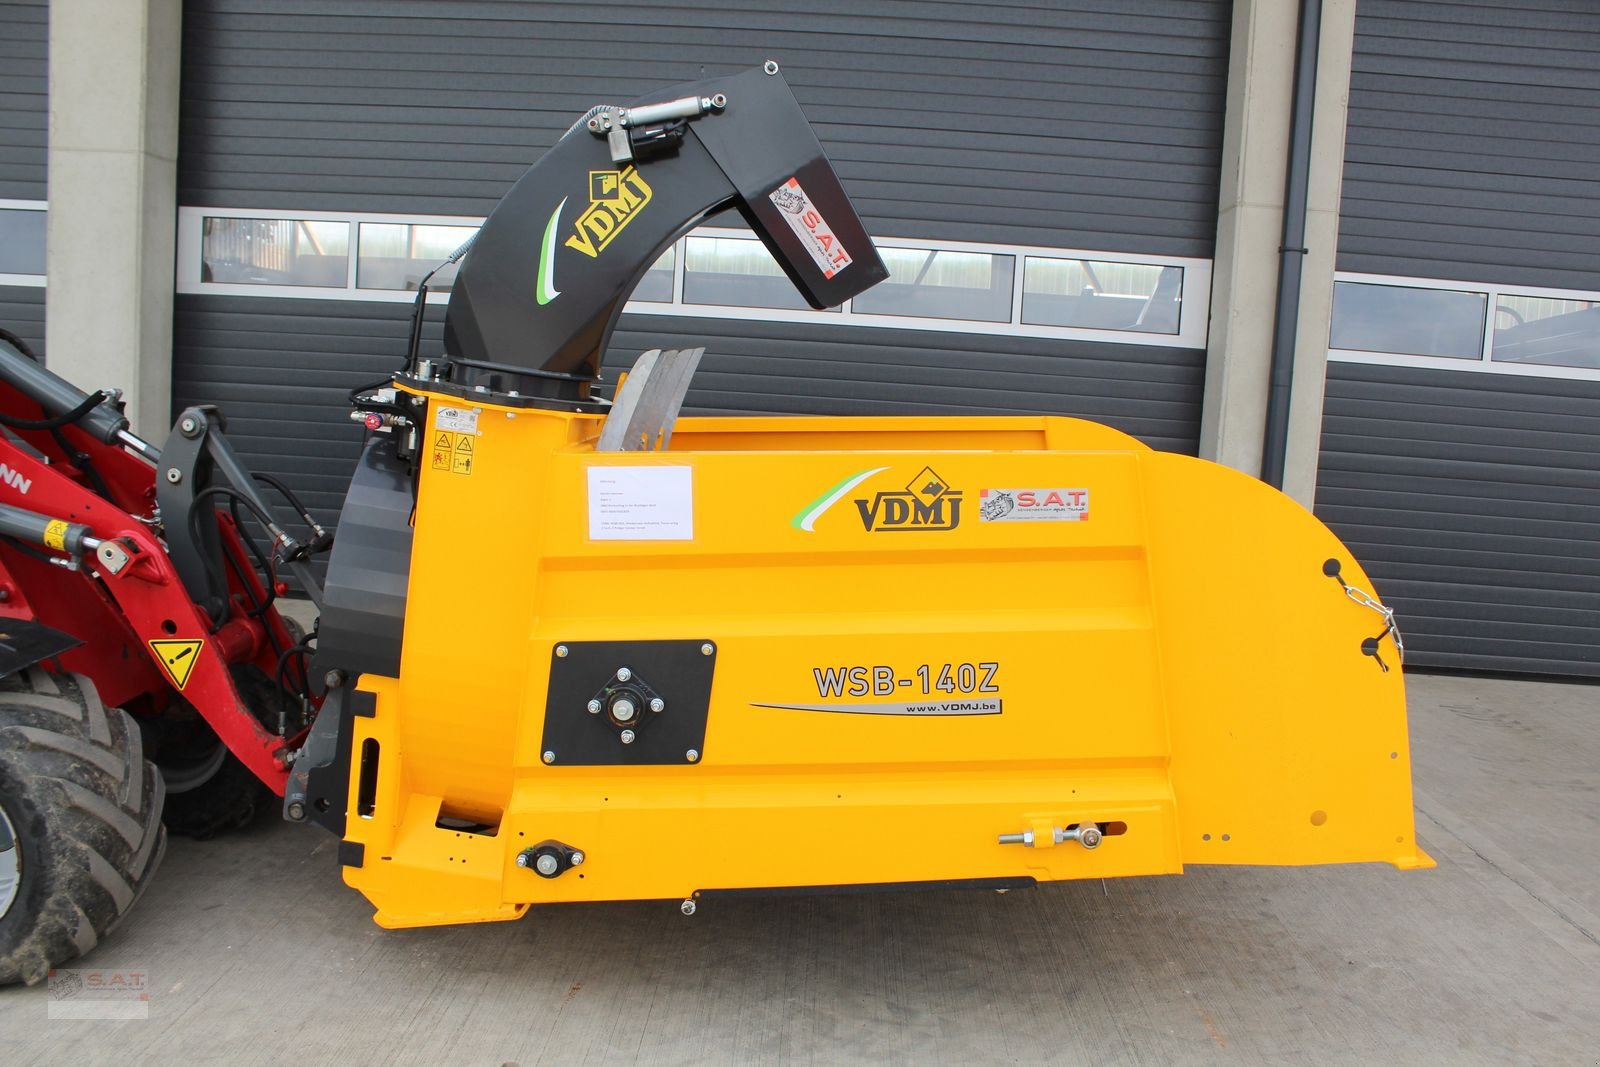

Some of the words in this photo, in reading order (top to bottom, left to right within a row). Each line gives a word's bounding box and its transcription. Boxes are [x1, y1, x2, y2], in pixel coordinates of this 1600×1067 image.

[564, 166, 654, 258] VDMJ
[802, 209, 849, 269] S.A.T.
[854, 491, 963, 532] VDMJ
[1016, 491, 1086, 507] S.A.T.
[813, 662, 999, 698] WSB-140Z
[906, 702, 997, 713] www.VDMJ.be
